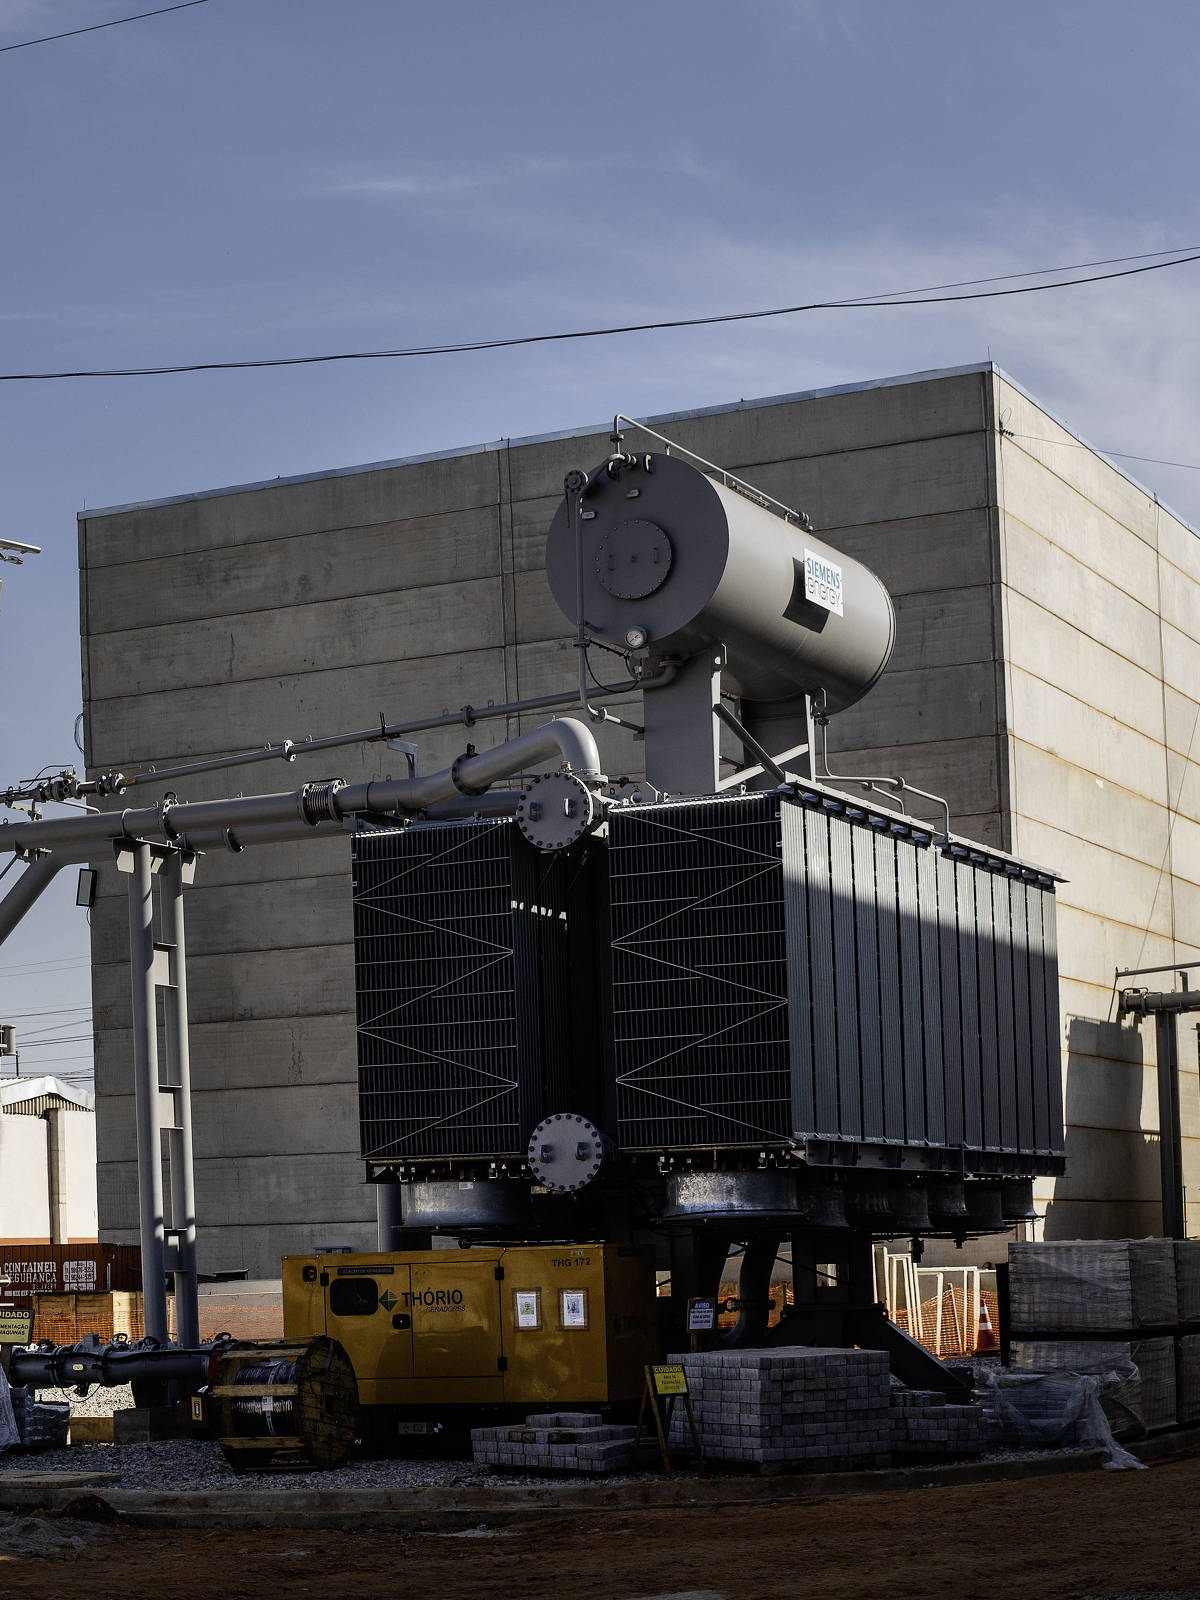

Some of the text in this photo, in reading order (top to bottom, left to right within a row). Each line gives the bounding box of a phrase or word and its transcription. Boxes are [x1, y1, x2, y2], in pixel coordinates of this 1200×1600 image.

[807, 557, 840, 590] SIEMENS
[4, 1261, 57, 1273] CONTAINER
[552, 1257, 591, 1267] THG 172
[401, 1288, 464, 1307] THÓRIO
[425, 1305, 466, 1313] GERADORES
[654, 1366, 683, 1374] CUIDADO
